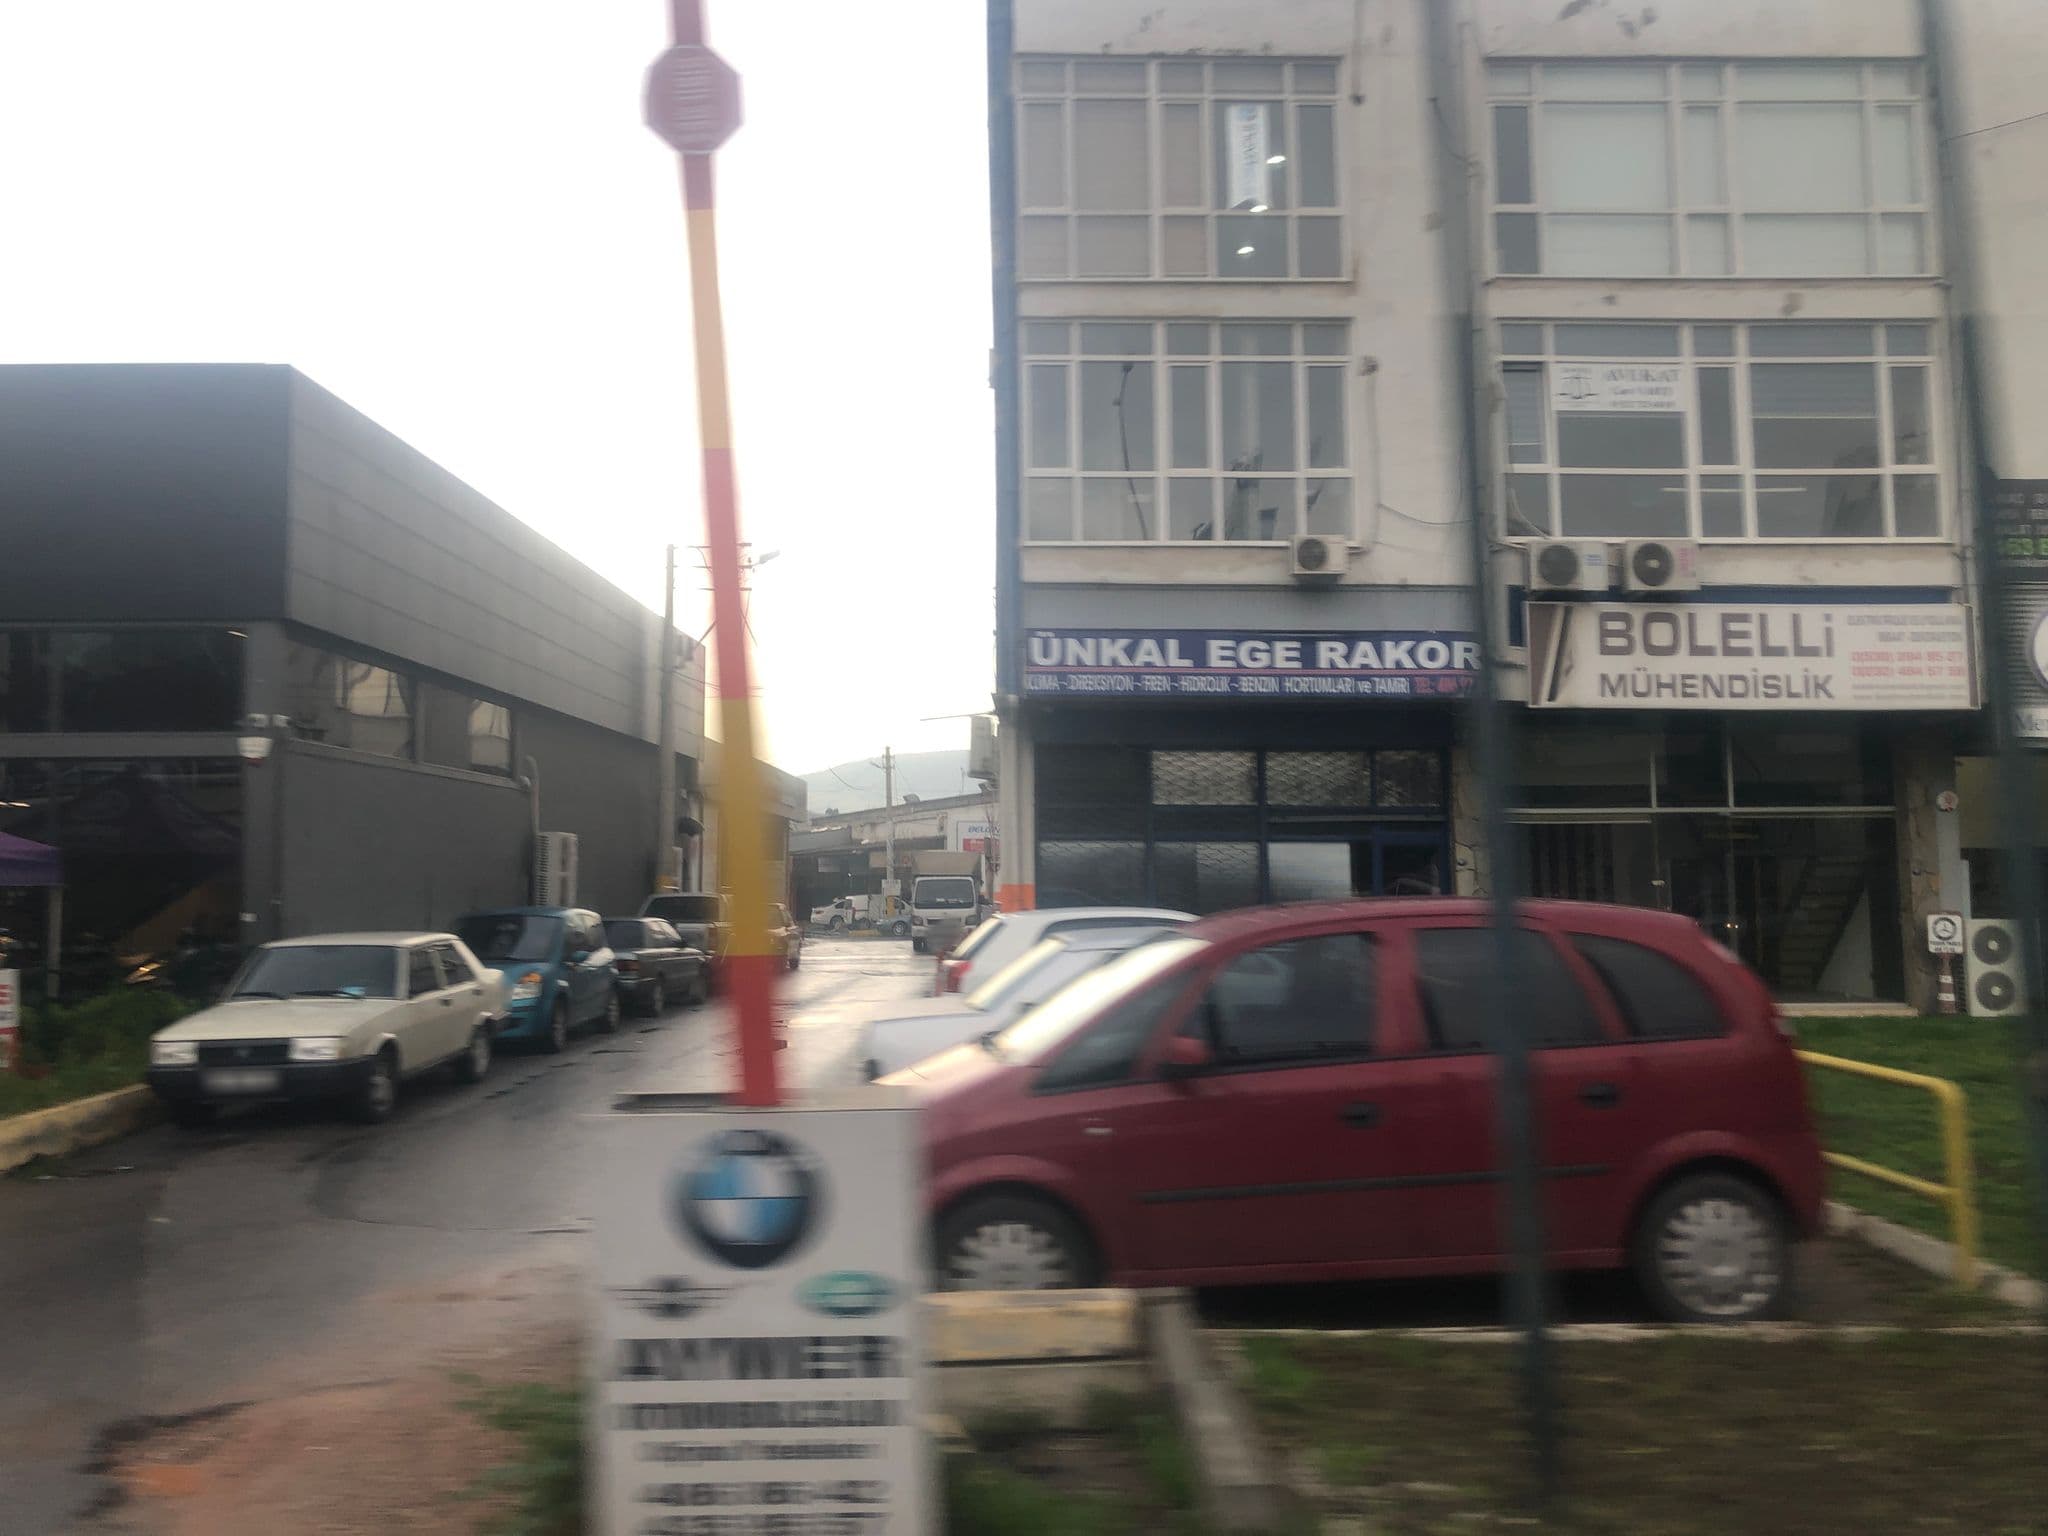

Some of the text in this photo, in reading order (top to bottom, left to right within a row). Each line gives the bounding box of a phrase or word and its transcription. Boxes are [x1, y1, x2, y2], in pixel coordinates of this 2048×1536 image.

[1029, 631, 1482, 670] ÜNKAL EGE RAKOR
[1143, 675, 1171, 692] FREN
[1358, 681, 1372, 694] ve
[1599, 667, 1834, 700] MÜHENDİSLİK
